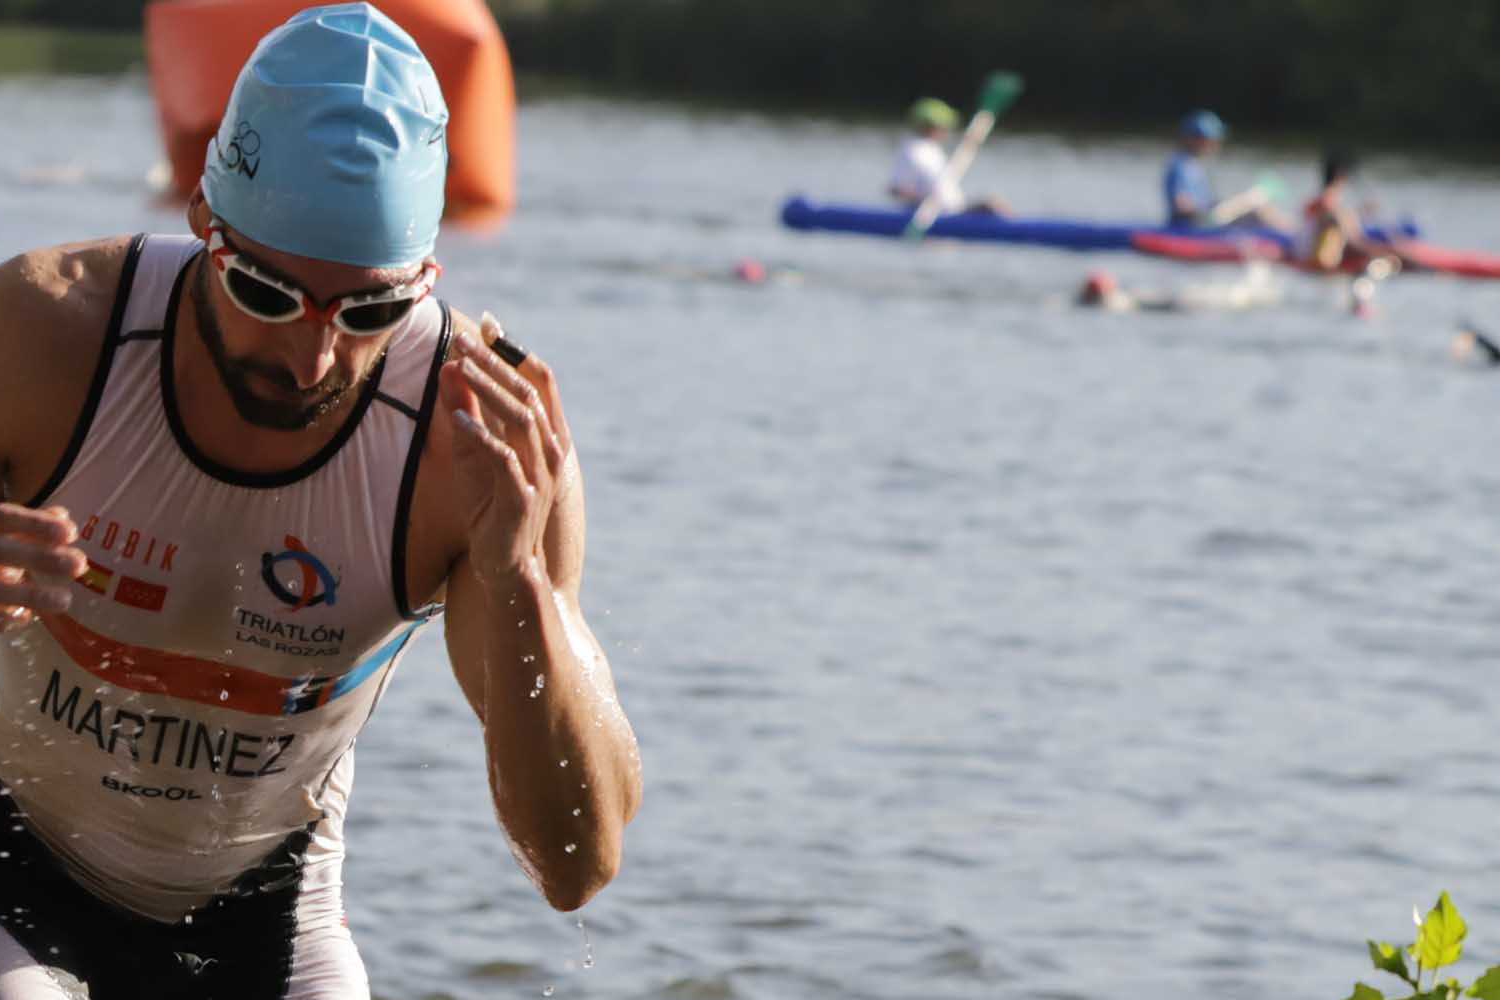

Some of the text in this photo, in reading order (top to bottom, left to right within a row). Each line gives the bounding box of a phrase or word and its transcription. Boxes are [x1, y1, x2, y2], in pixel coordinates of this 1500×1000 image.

[80, 514, 179, 572] GOBIK
[235, 630, 342, 657] LAS ROZAS
[237, 607, 346, 643] TRIATLÓN
[39, 669, 295, 778] MARTINEZ
